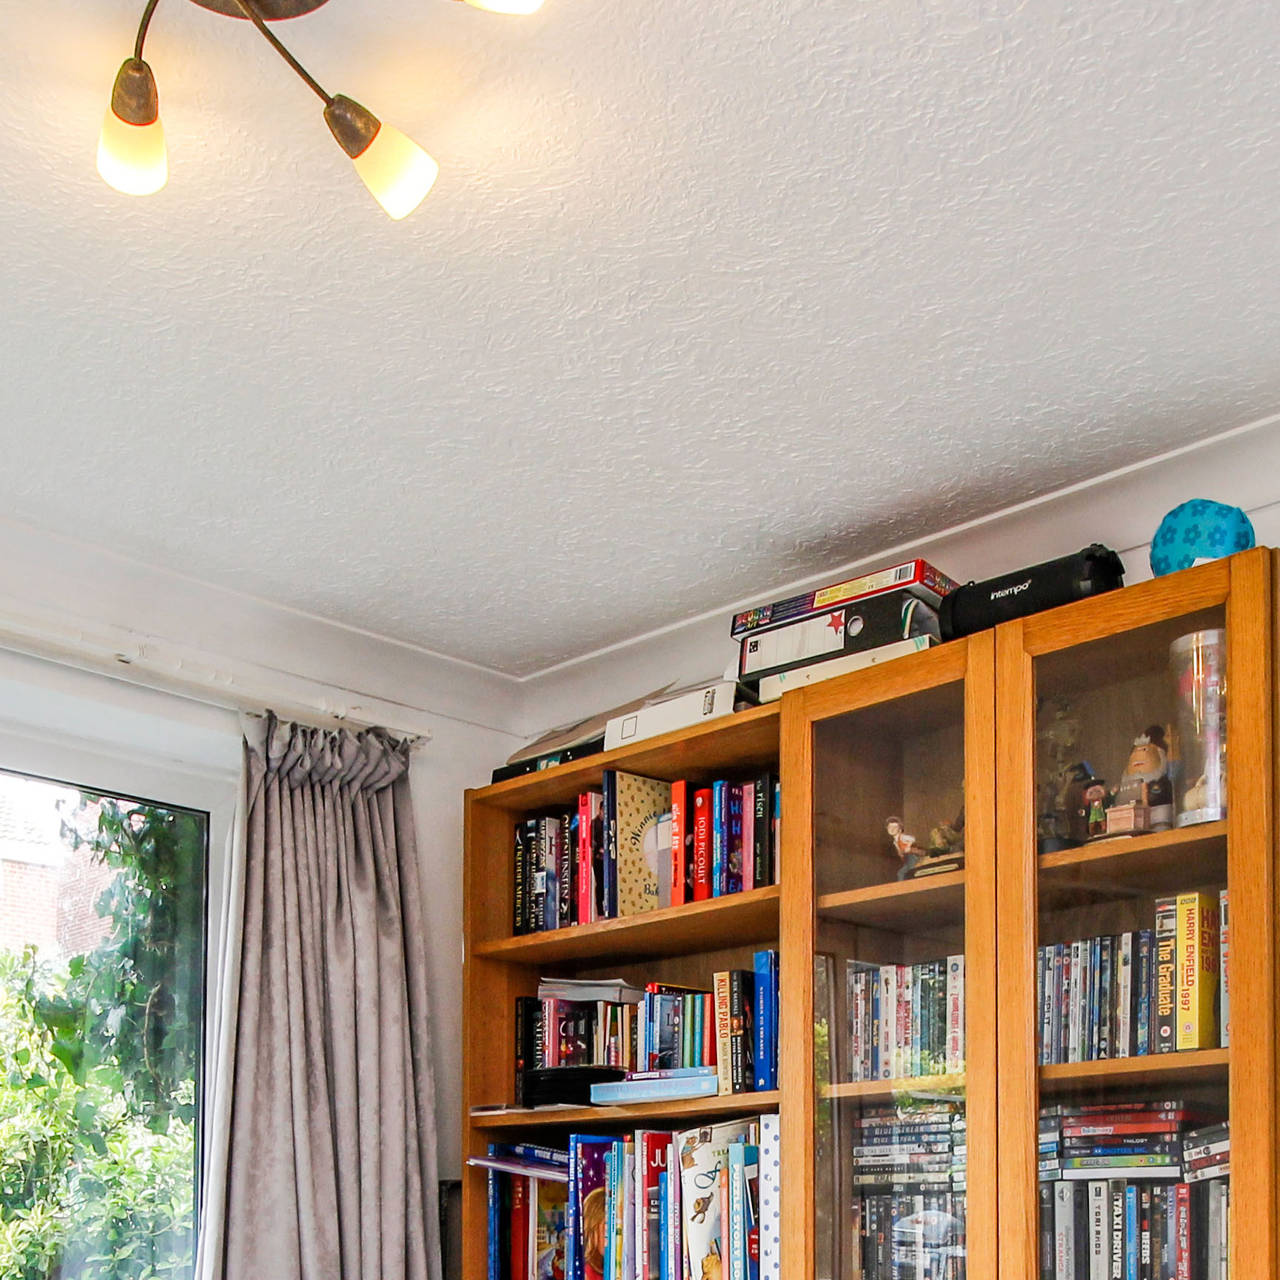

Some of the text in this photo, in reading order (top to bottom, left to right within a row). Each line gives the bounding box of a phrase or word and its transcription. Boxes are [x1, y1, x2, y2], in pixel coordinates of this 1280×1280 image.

[990, 582, 1030, 601] intempo
[630, 811, 658, 847] Winnie
[755, 792, 765, 818] risen
[515, 845, 524, 928] FREDDIE MERCURY
[697, 841, 707, 885] PICOULT
[1158, 938, 1175, 1016] The Graduate
[1181, 907, 1196, 1012] HARRY ENFIELD 1997
[717, 978, 729, 1039] KILLING PABLO
[535, 1020, 544, 1070] STEPHEN
[731, 1163, 742, 1212] PUZZLE
[731, 1213, 742, 1257] STORY
[1112, 1198, 1123, 1279] TAXI DRIVER
[1140, 1231, 1150, 1264] DEEDS
